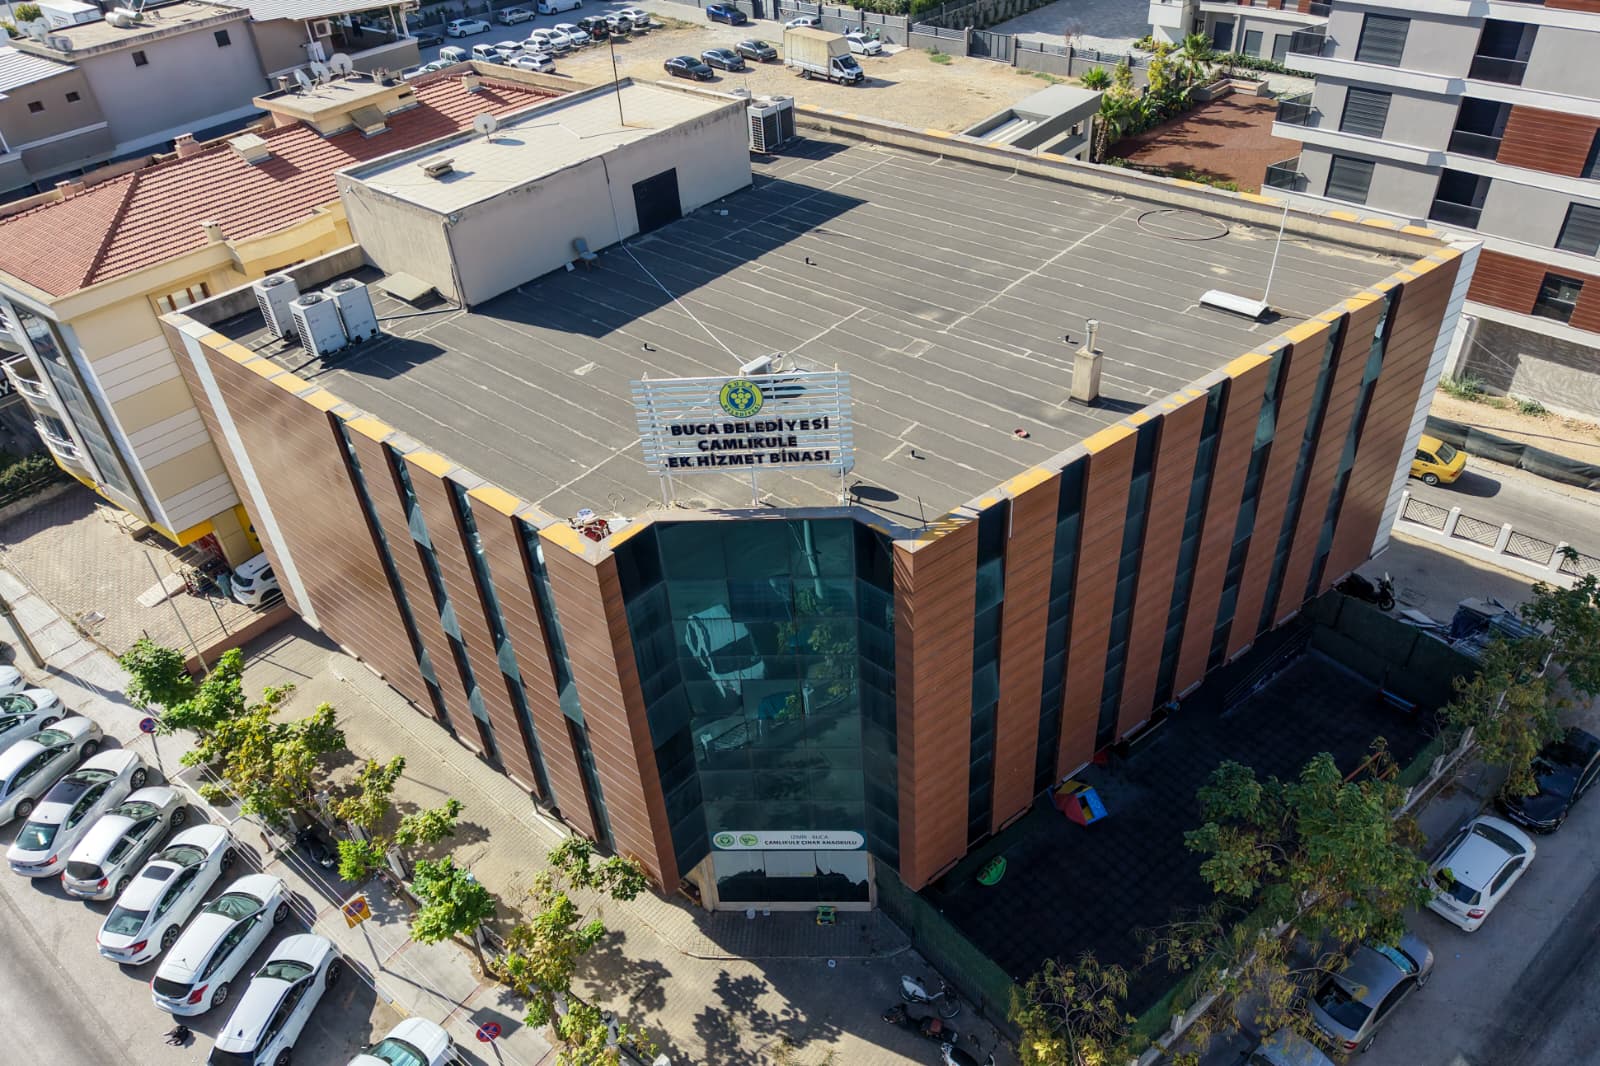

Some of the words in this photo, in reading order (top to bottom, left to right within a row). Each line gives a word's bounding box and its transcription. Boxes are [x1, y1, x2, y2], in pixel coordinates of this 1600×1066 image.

[671, 424, 719, 436] BUCA
[724, 416, 829, 433] BELEDİYESİ
[697, 436, 797, 451] ÇAMLIKULE
[668, 456, 692, 468] EK
[696, 452, 765, 467] HİZMET
[769, 448, 830, 464] BİNASI
